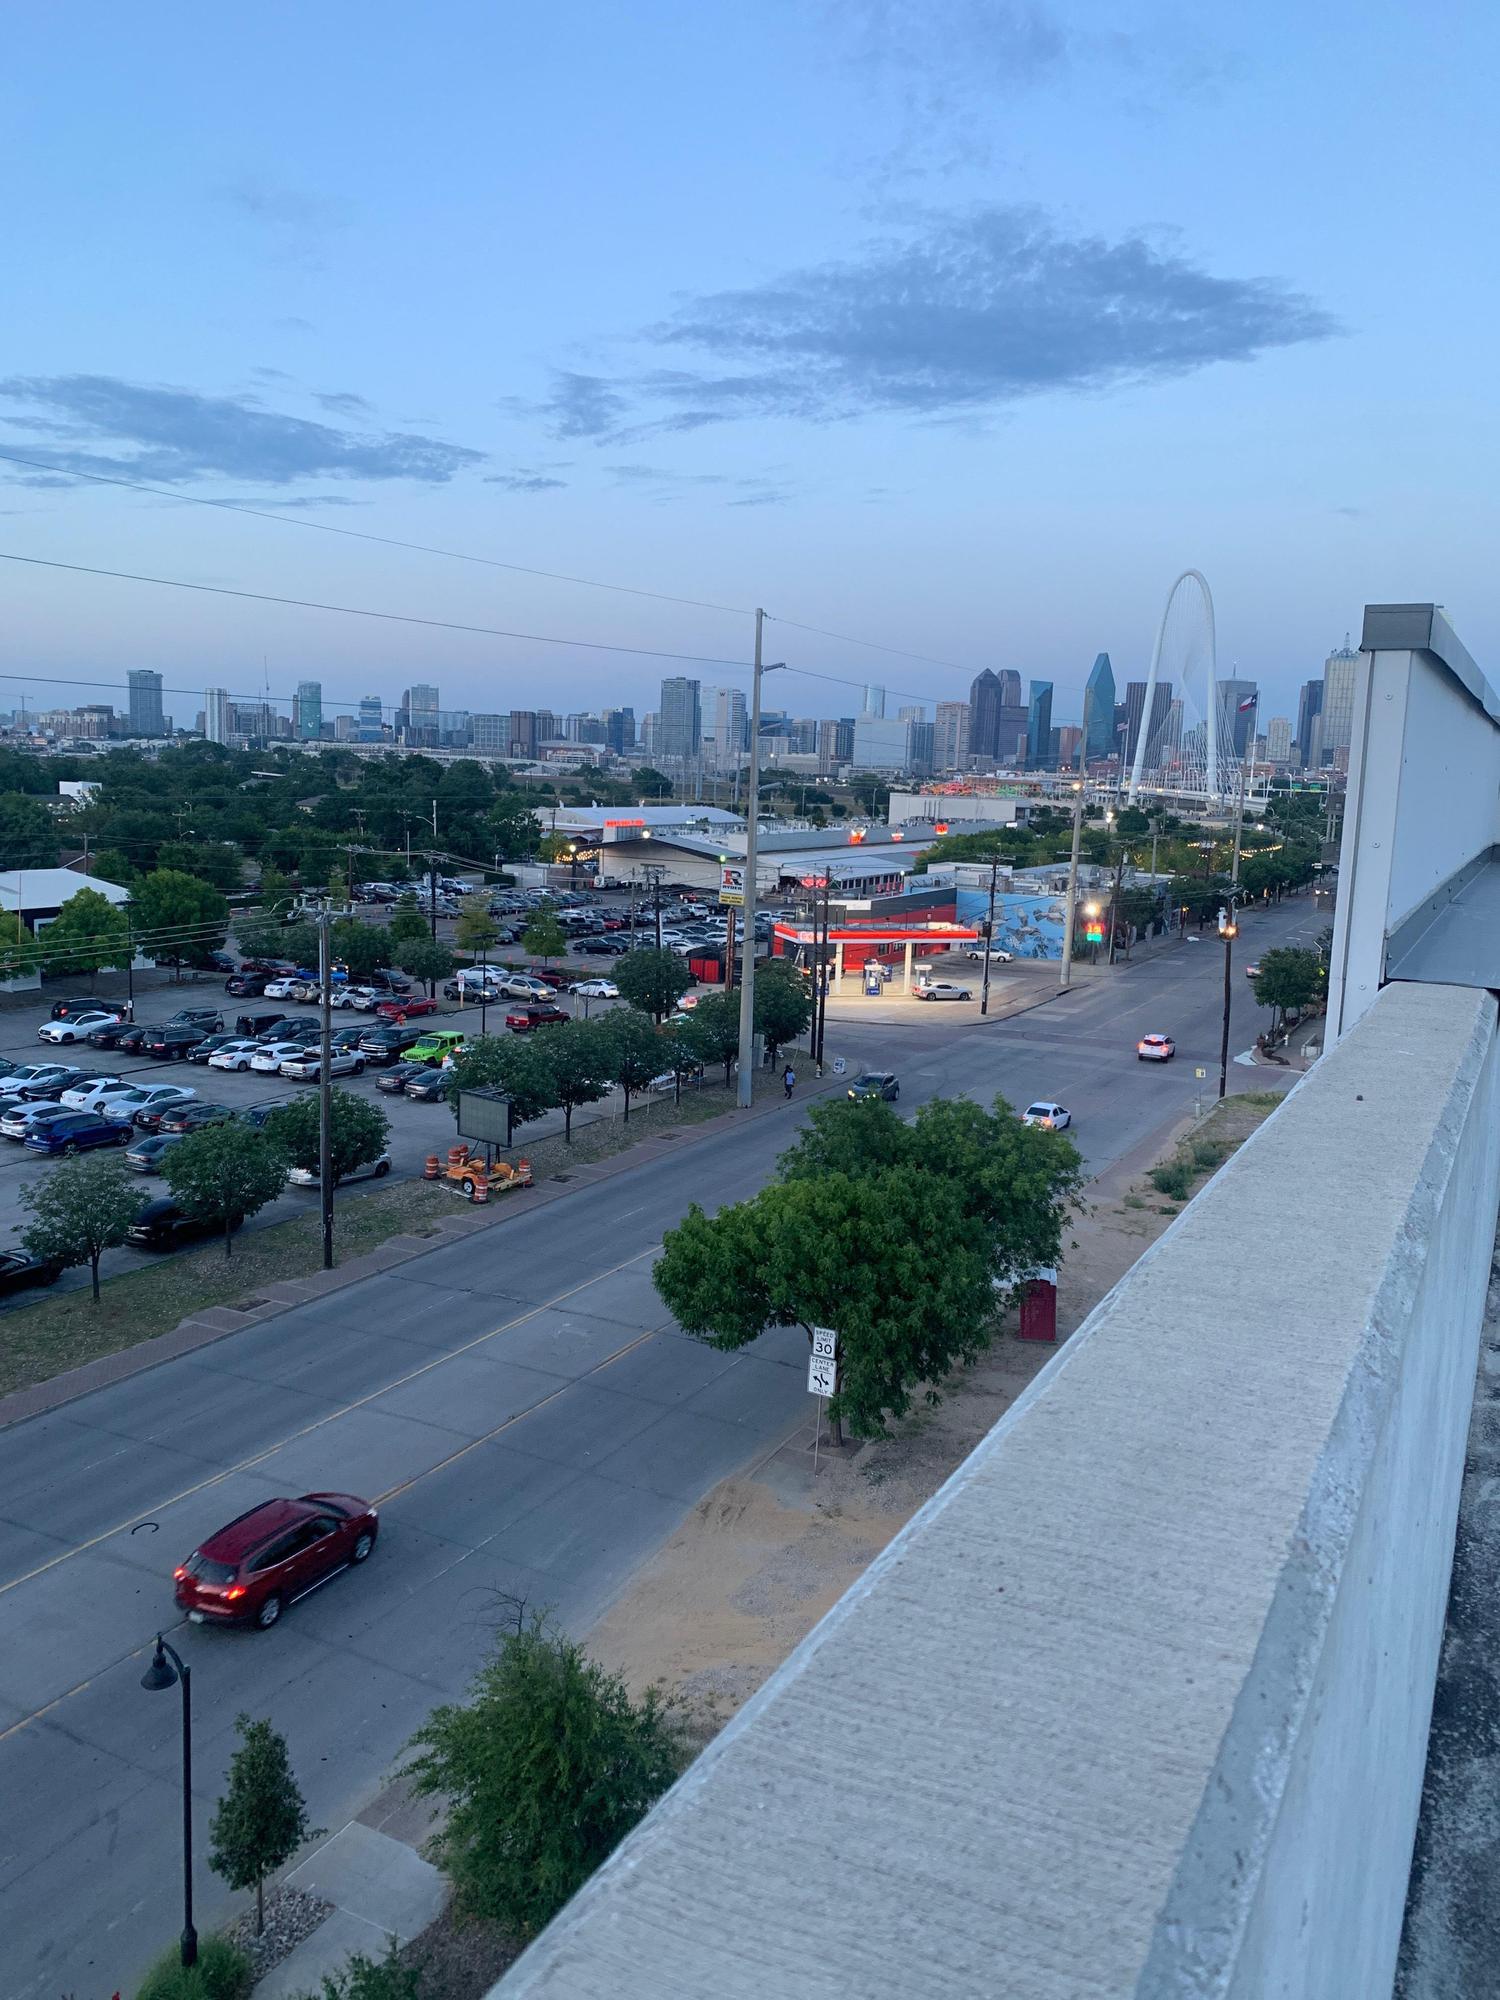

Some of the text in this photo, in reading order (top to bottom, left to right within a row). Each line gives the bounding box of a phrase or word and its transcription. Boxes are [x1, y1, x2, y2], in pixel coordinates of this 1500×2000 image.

[816, 1330, 834, 1338] SPEED
[816, 1342, 832, 1354] 30
[812, 1358, 834, 1367] CENTER
